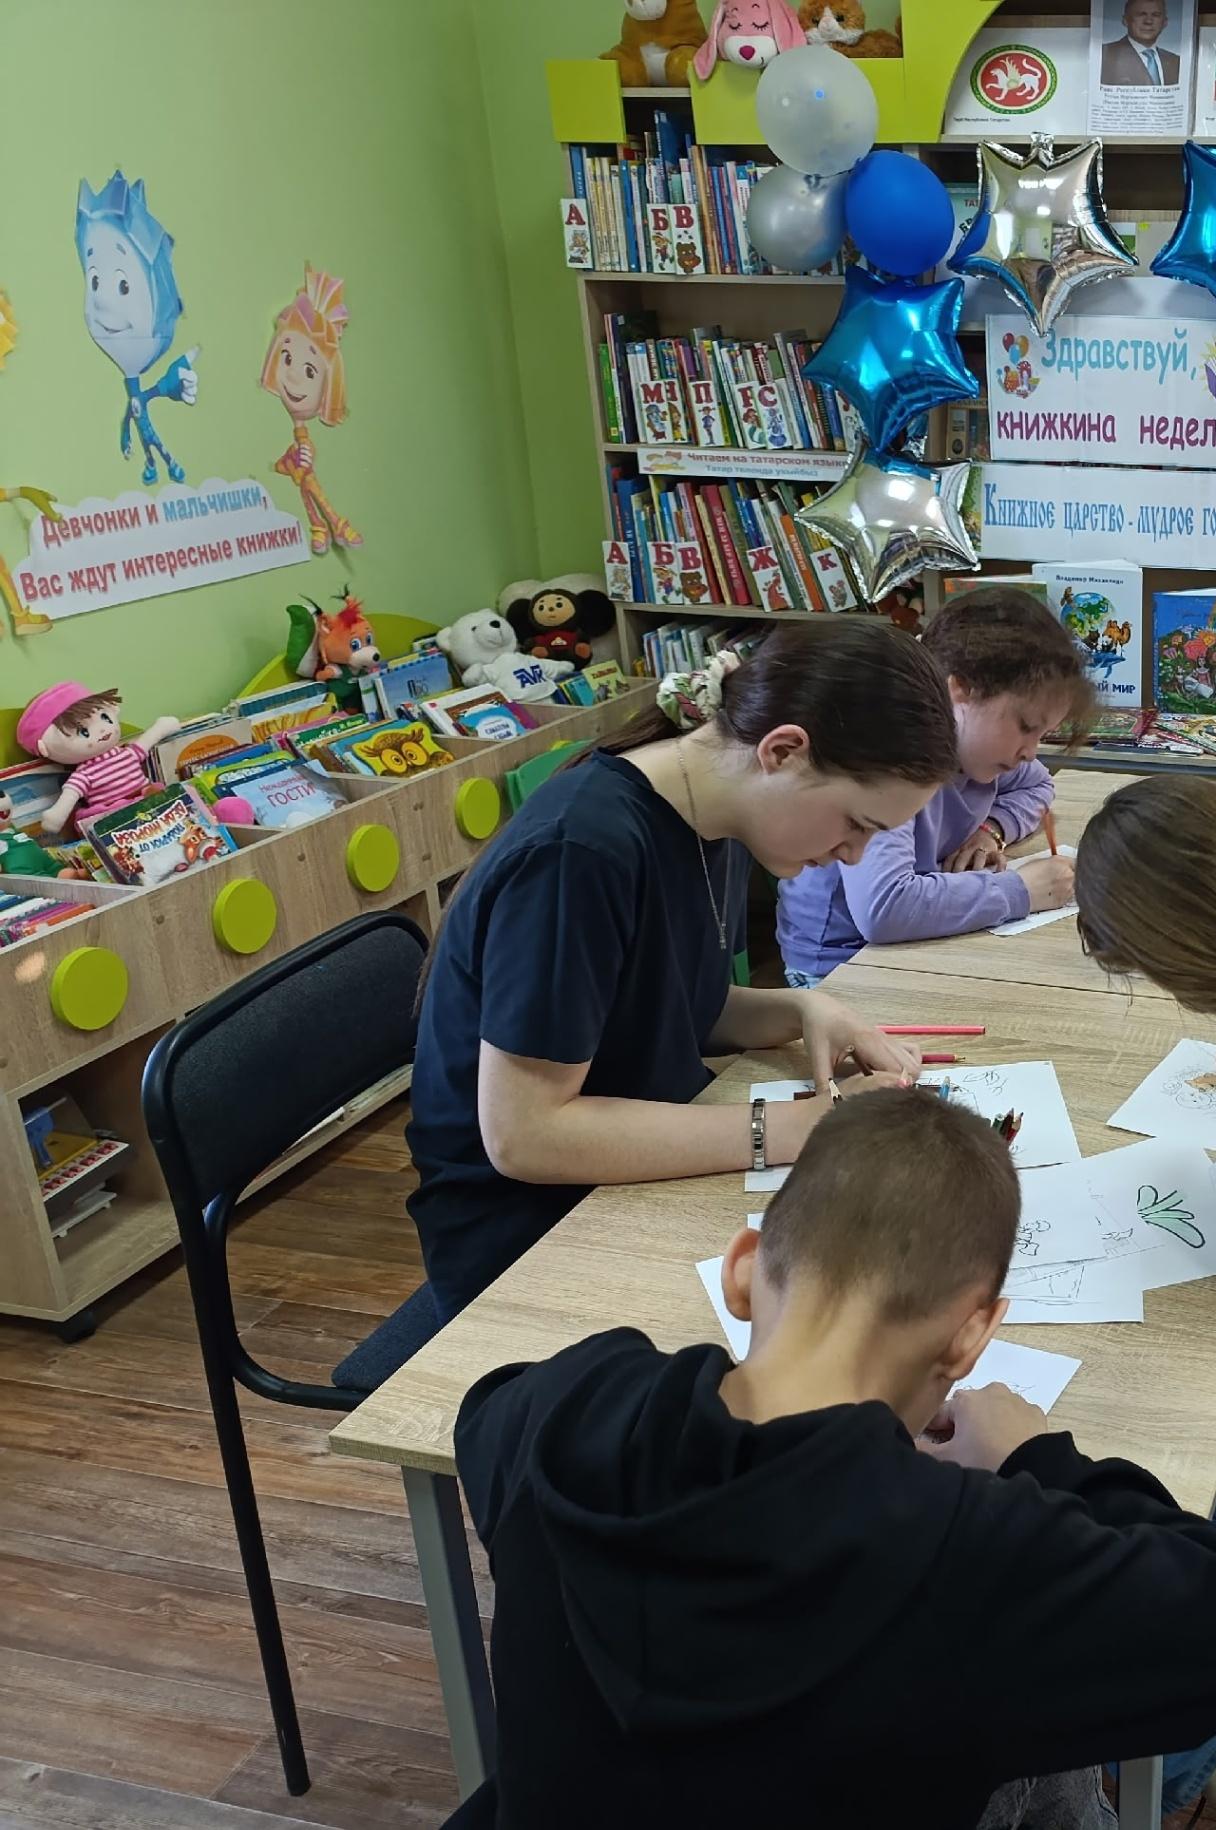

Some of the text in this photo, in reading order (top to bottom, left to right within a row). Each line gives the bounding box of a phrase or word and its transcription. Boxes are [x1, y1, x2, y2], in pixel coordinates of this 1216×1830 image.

[565, 203, 586, 226] А
[651, 208, 669, 231] Б
[673, 206, 694, 228] В
[1040, 328, 1197, 385] Здравствуй,
[641, 382, 666, 404] М
[692, 382, 714, 404] П
[758, 386, 777, 407] С
[996, 410, 1117, 444] книжкина
[687, 453, 731, 464] Читаем
[733, 455, 747, 463] на
[750, 455, 810, 466] татарском
[41, 485, 269, 549] Девчонки и мальчишки,
[19, 519, 304, 602] Вас ждут интересные книжки!
[606, 541, 628, 565] А
[651, 543, 675, 566] Б
[677, 546, 703, 571] В
[748, 546, 778, 572] Ж
[817, 553, 838, 571] К
[1112, 683, 1136, 695] МИР
[267, 782, 317, 808] ГОСТИ
